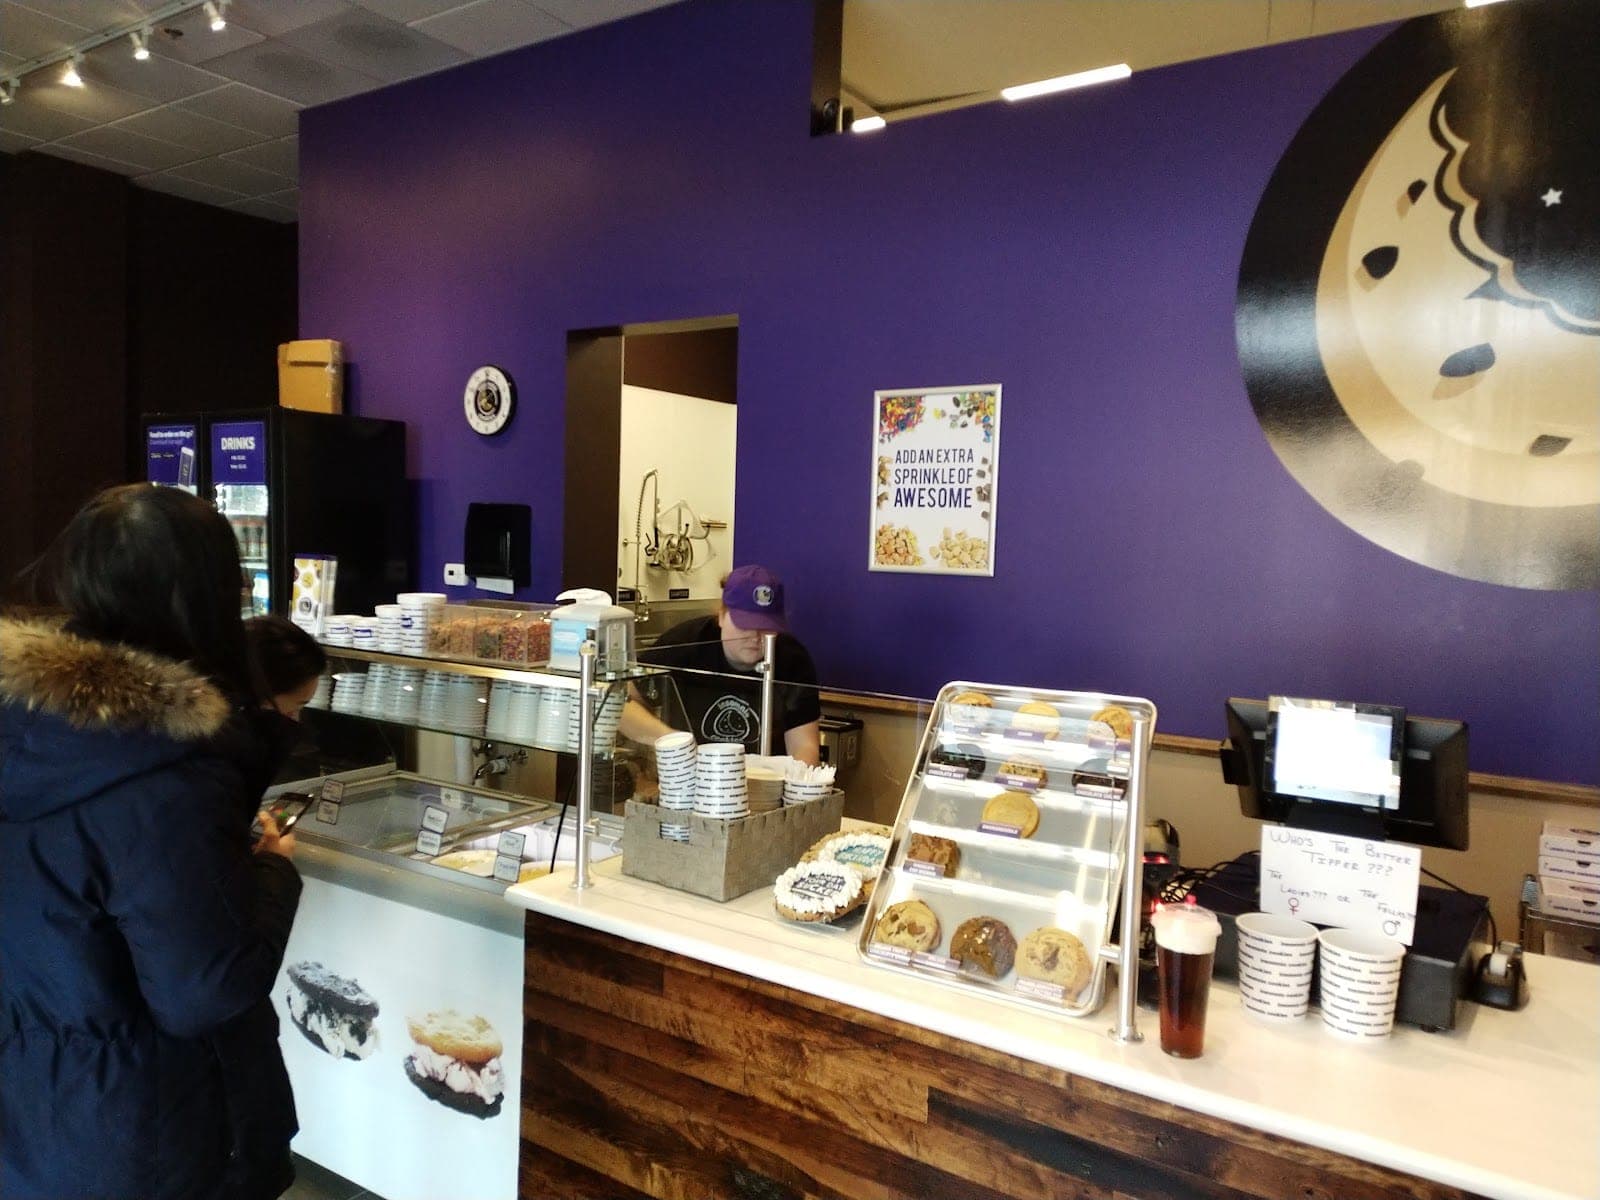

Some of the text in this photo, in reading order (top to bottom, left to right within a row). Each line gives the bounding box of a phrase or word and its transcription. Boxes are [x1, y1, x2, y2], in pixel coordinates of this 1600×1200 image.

[221, 436, 256, 451] DRINKS
[895, 448, 975, 465] ADD AN EXTRA
[894, 467, 974, 485] SPRINKLE OF
[894, 487, 973, 508] AWESOME
